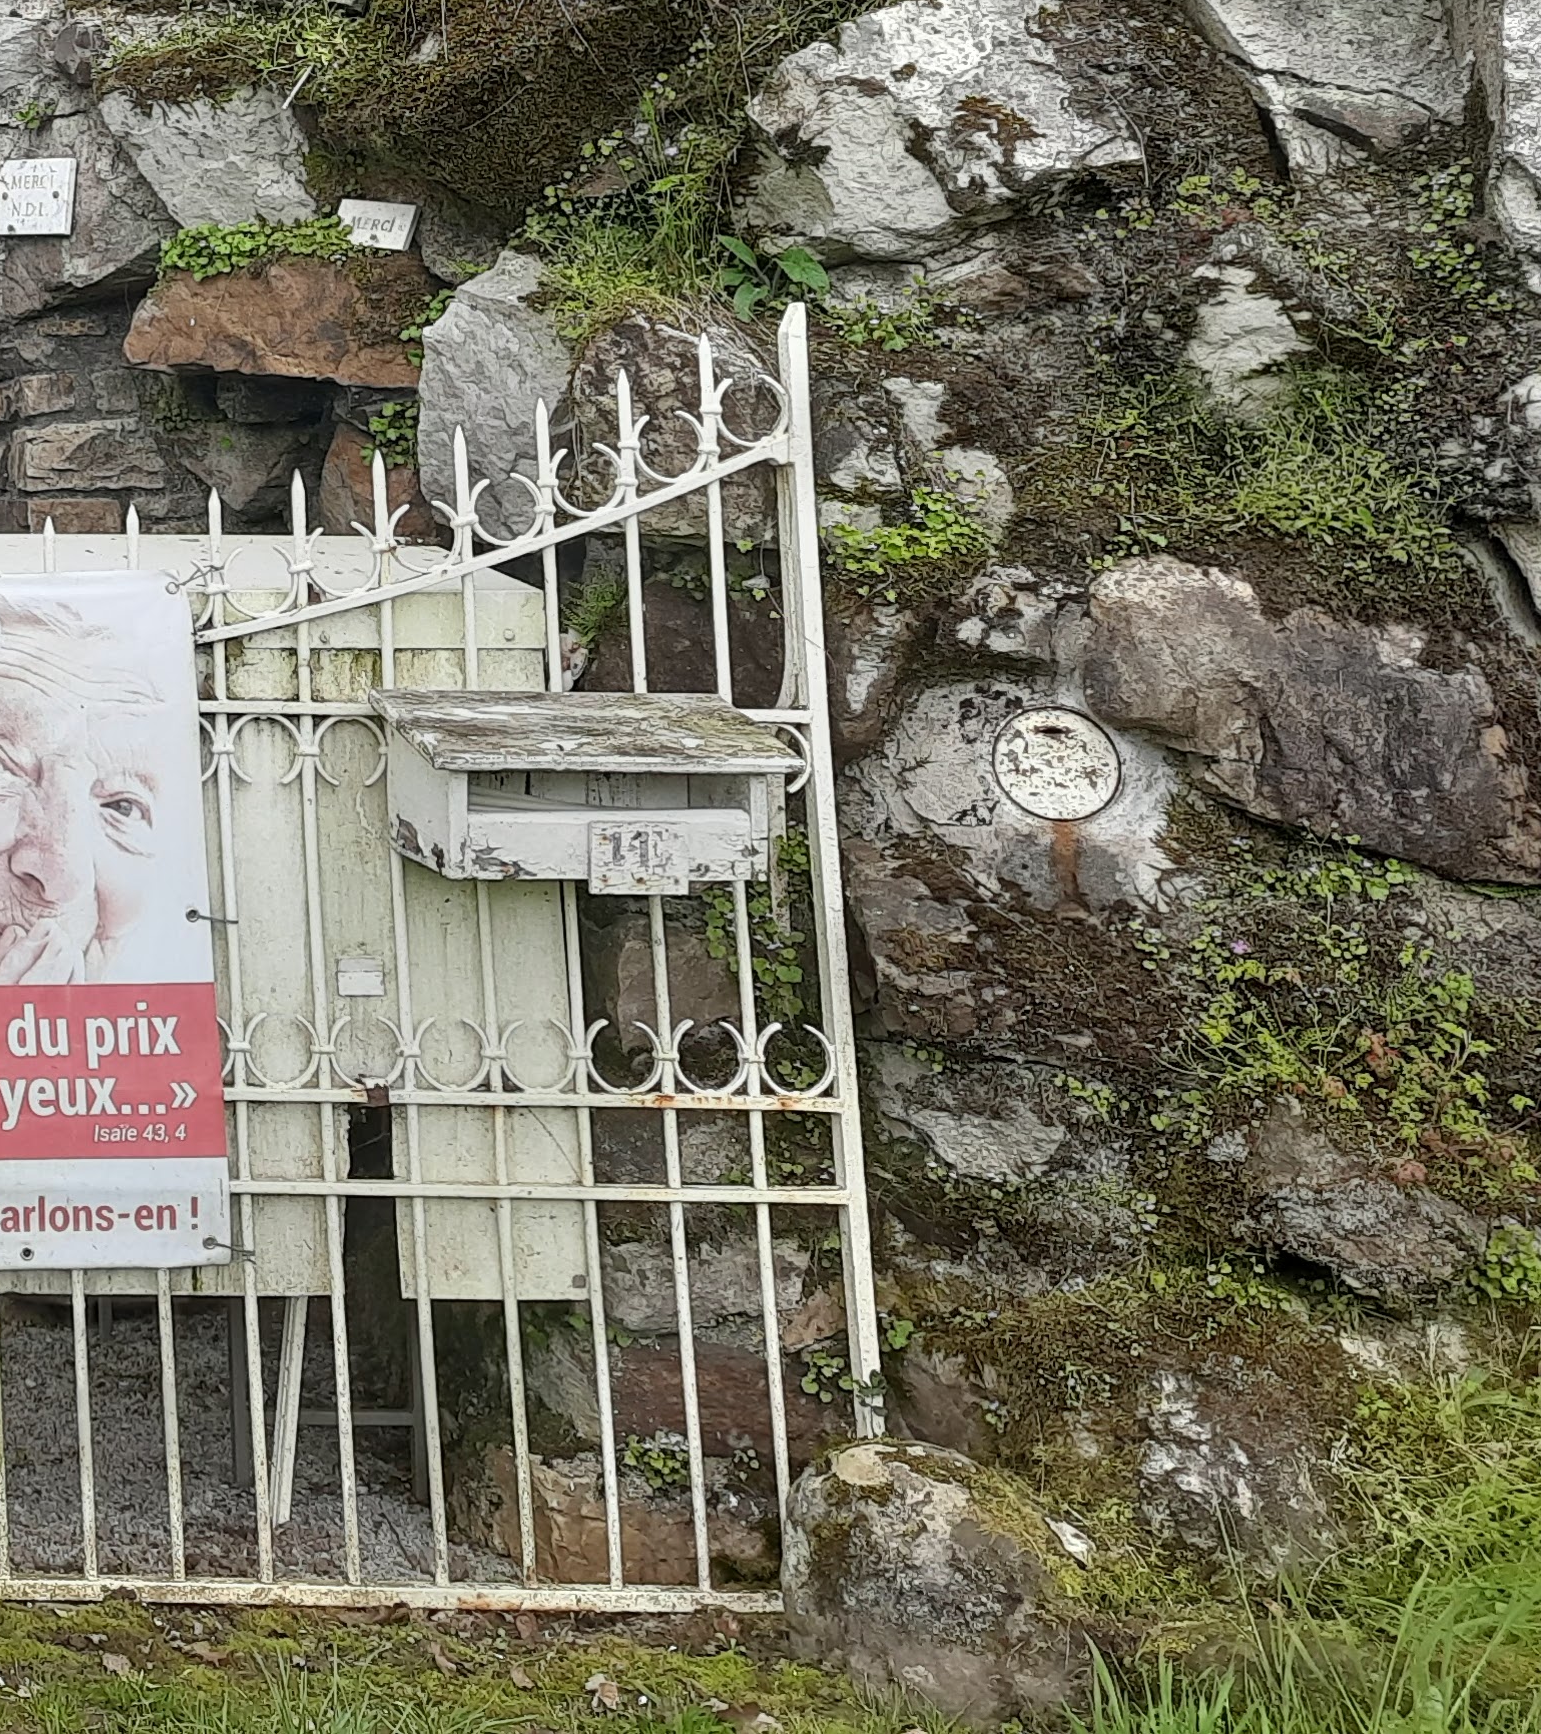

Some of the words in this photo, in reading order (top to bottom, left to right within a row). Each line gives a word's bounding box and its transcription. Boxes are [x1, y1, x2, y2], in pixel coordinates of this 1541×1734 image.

[11, 175, 55, 190] MERCI
[351, 216, 396, 233] MERCI
[7, 1003, 69, 1057] du
[85, 1002, 182, 1069] prix
[93, 1124, 138, 1143] Isaïe
[142, 1124, 170, 1144] 43,
[173, 1124, 187, 1141] 4
[190, 1196, 199, 1231] !
